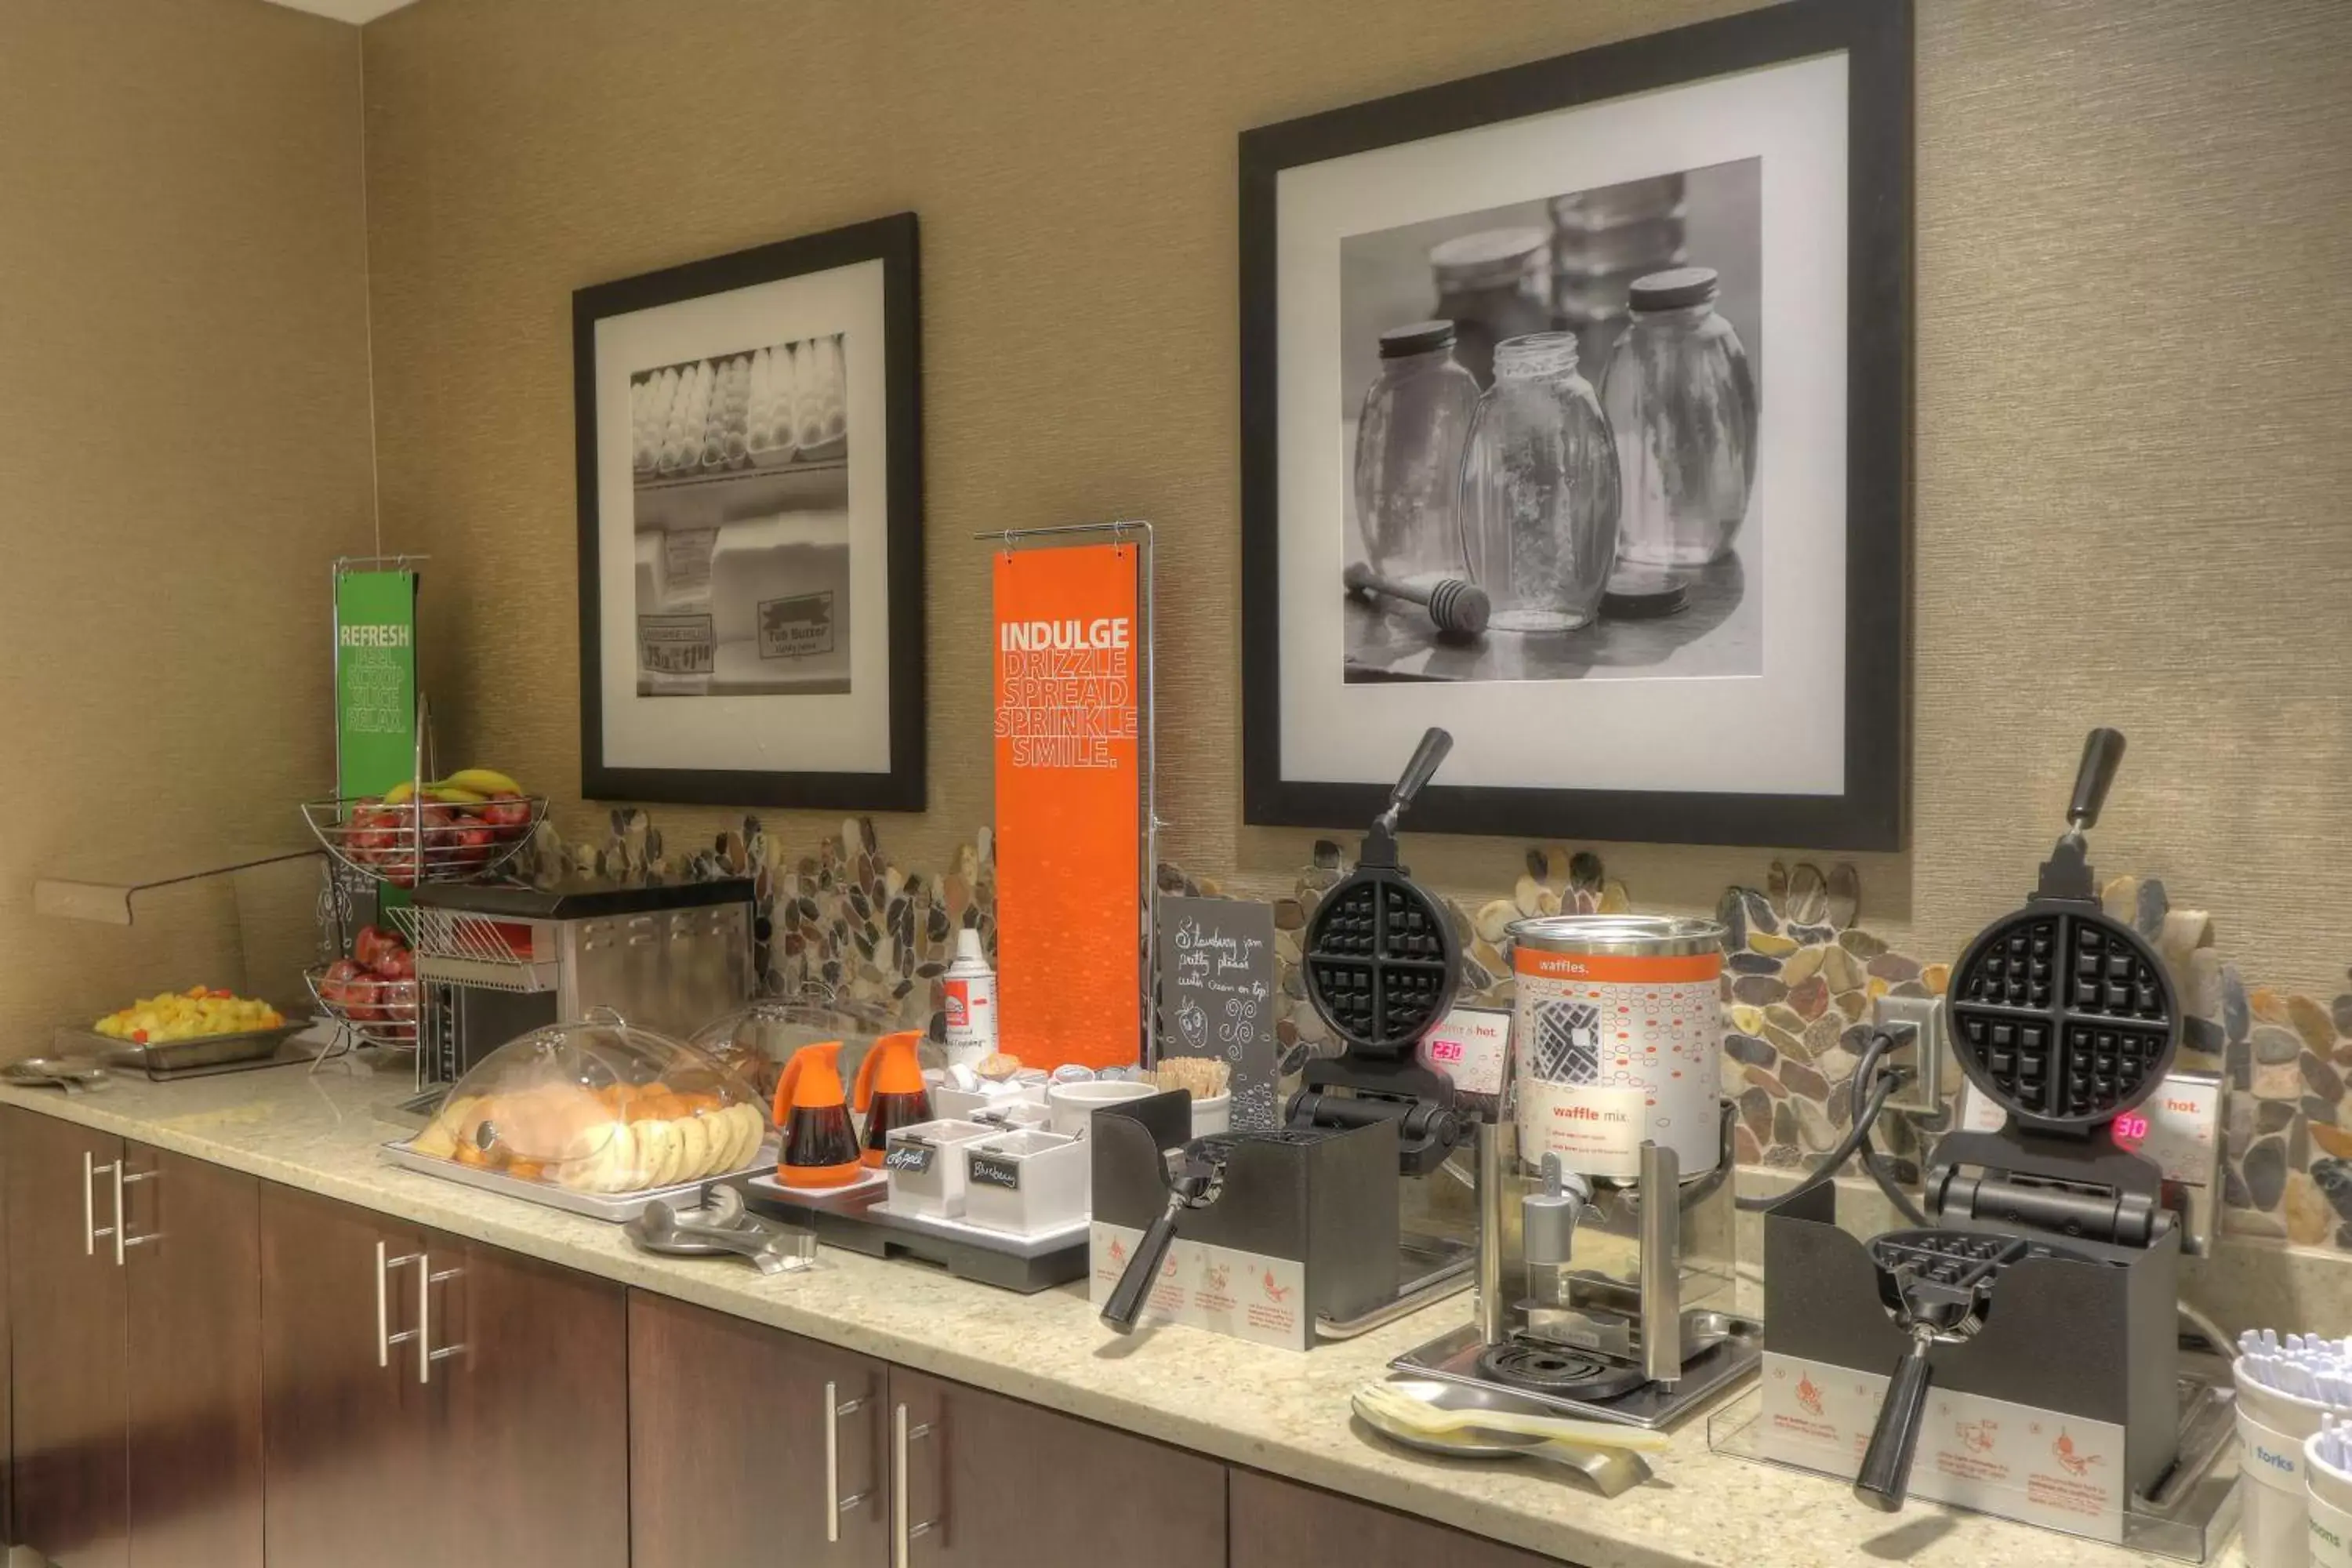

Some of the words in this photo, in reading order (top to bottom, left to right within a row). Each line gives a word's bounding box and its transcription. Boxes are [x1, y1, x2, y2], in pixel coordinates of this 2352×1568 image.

[340, 625, 409, 647] REFRESH
[1001, 619, 1129, 651] INDULGE
[1004, 648, 1127, 678] DRIZZLE
[352, 687, 400, 710] SLICE
[1004, 677, 1129, 708] SPREAD
[994, 706, 1138, 739] SPRINKLE
[1013, 735, 1118, 768] SMILE.
[1539, 959, 1590, 975] waffles.
[1238, 985, 1249, 994] on
[1553, 1106, 1599, 1121] waffle
[2167, 1099, 2200, 1112] hot.
